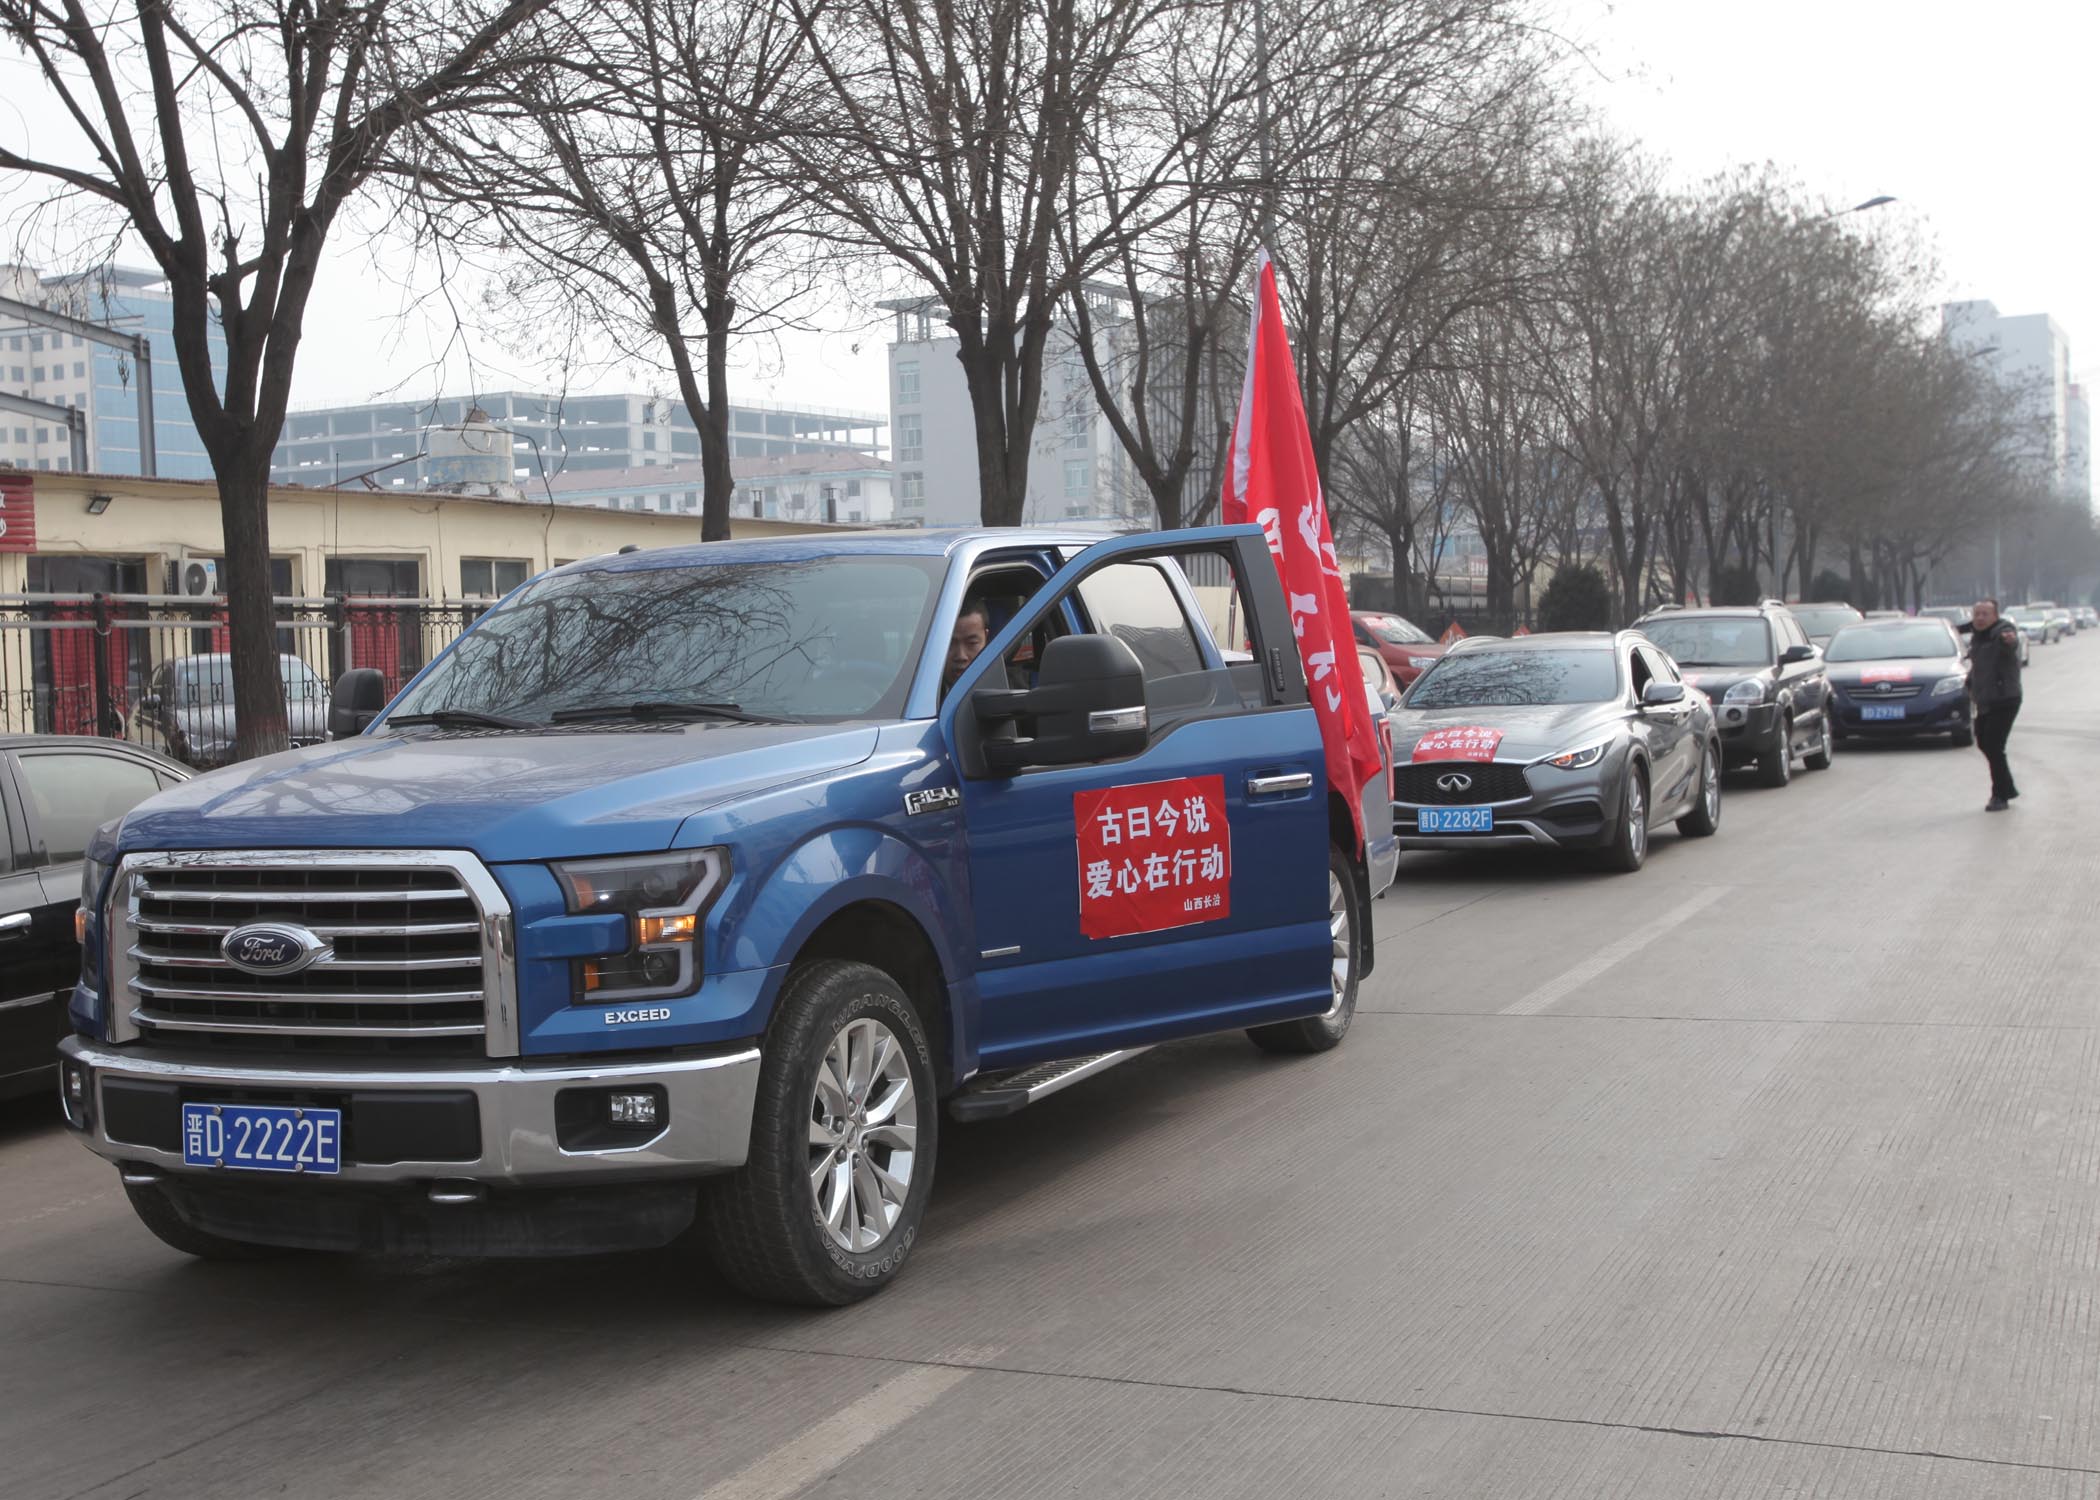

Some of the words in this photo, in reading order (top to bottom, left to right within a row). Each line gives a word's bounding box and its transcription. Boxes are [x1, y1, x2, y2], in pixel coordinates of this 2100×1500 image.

[1419, 739, 1495, 751] 爱心在行动
[1097, 796, 1209, 846] 古日今说
[1086, 843, 1224, 900] 爱心在行动
[1183, 893, 1221, 911] 山西长治
[240, 936, 286, 961] Ford
[604, 1008, 671, 1024] EXCEED
